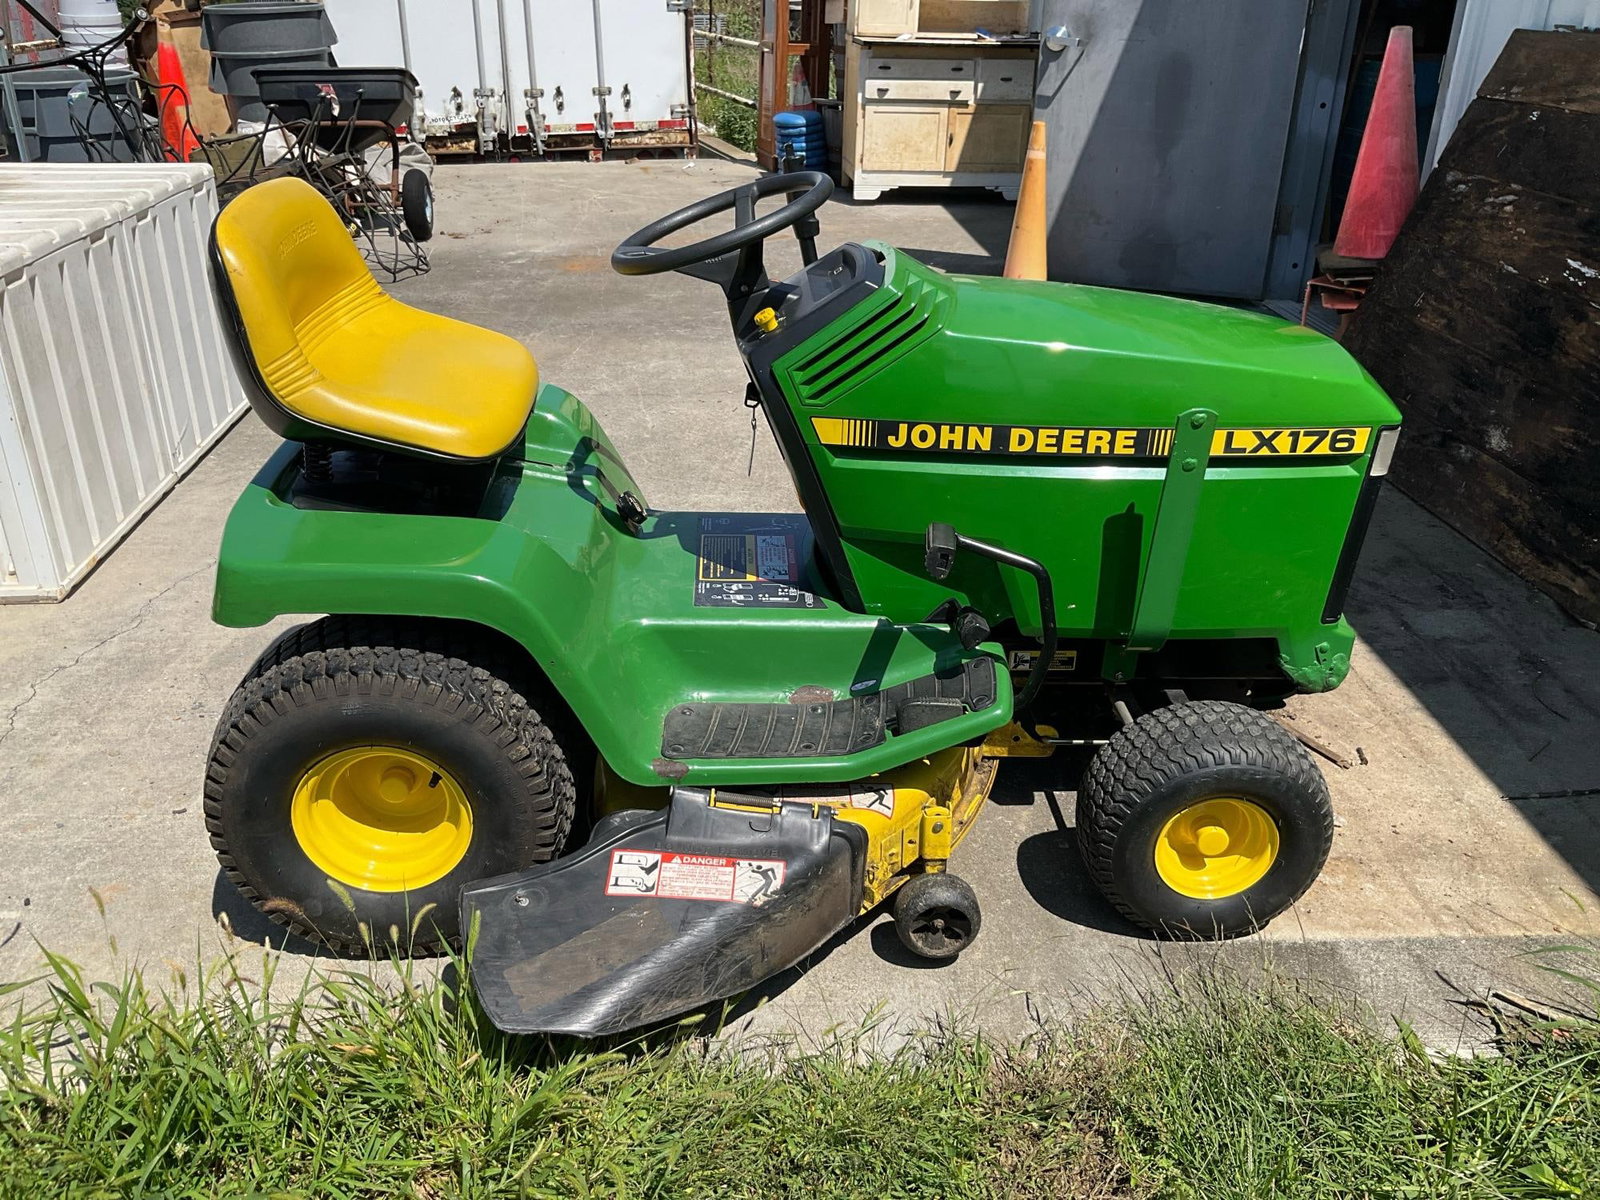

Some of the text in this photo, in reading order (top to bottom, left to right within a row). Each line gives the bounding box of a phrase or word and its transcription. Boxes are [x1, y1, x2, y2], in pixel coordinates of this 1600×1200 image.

[887, 423, 1138, 455] JOHN DEERE
[1222, 429, 1357, 455] LX176
[682, 855, 727, 866] DANGER
